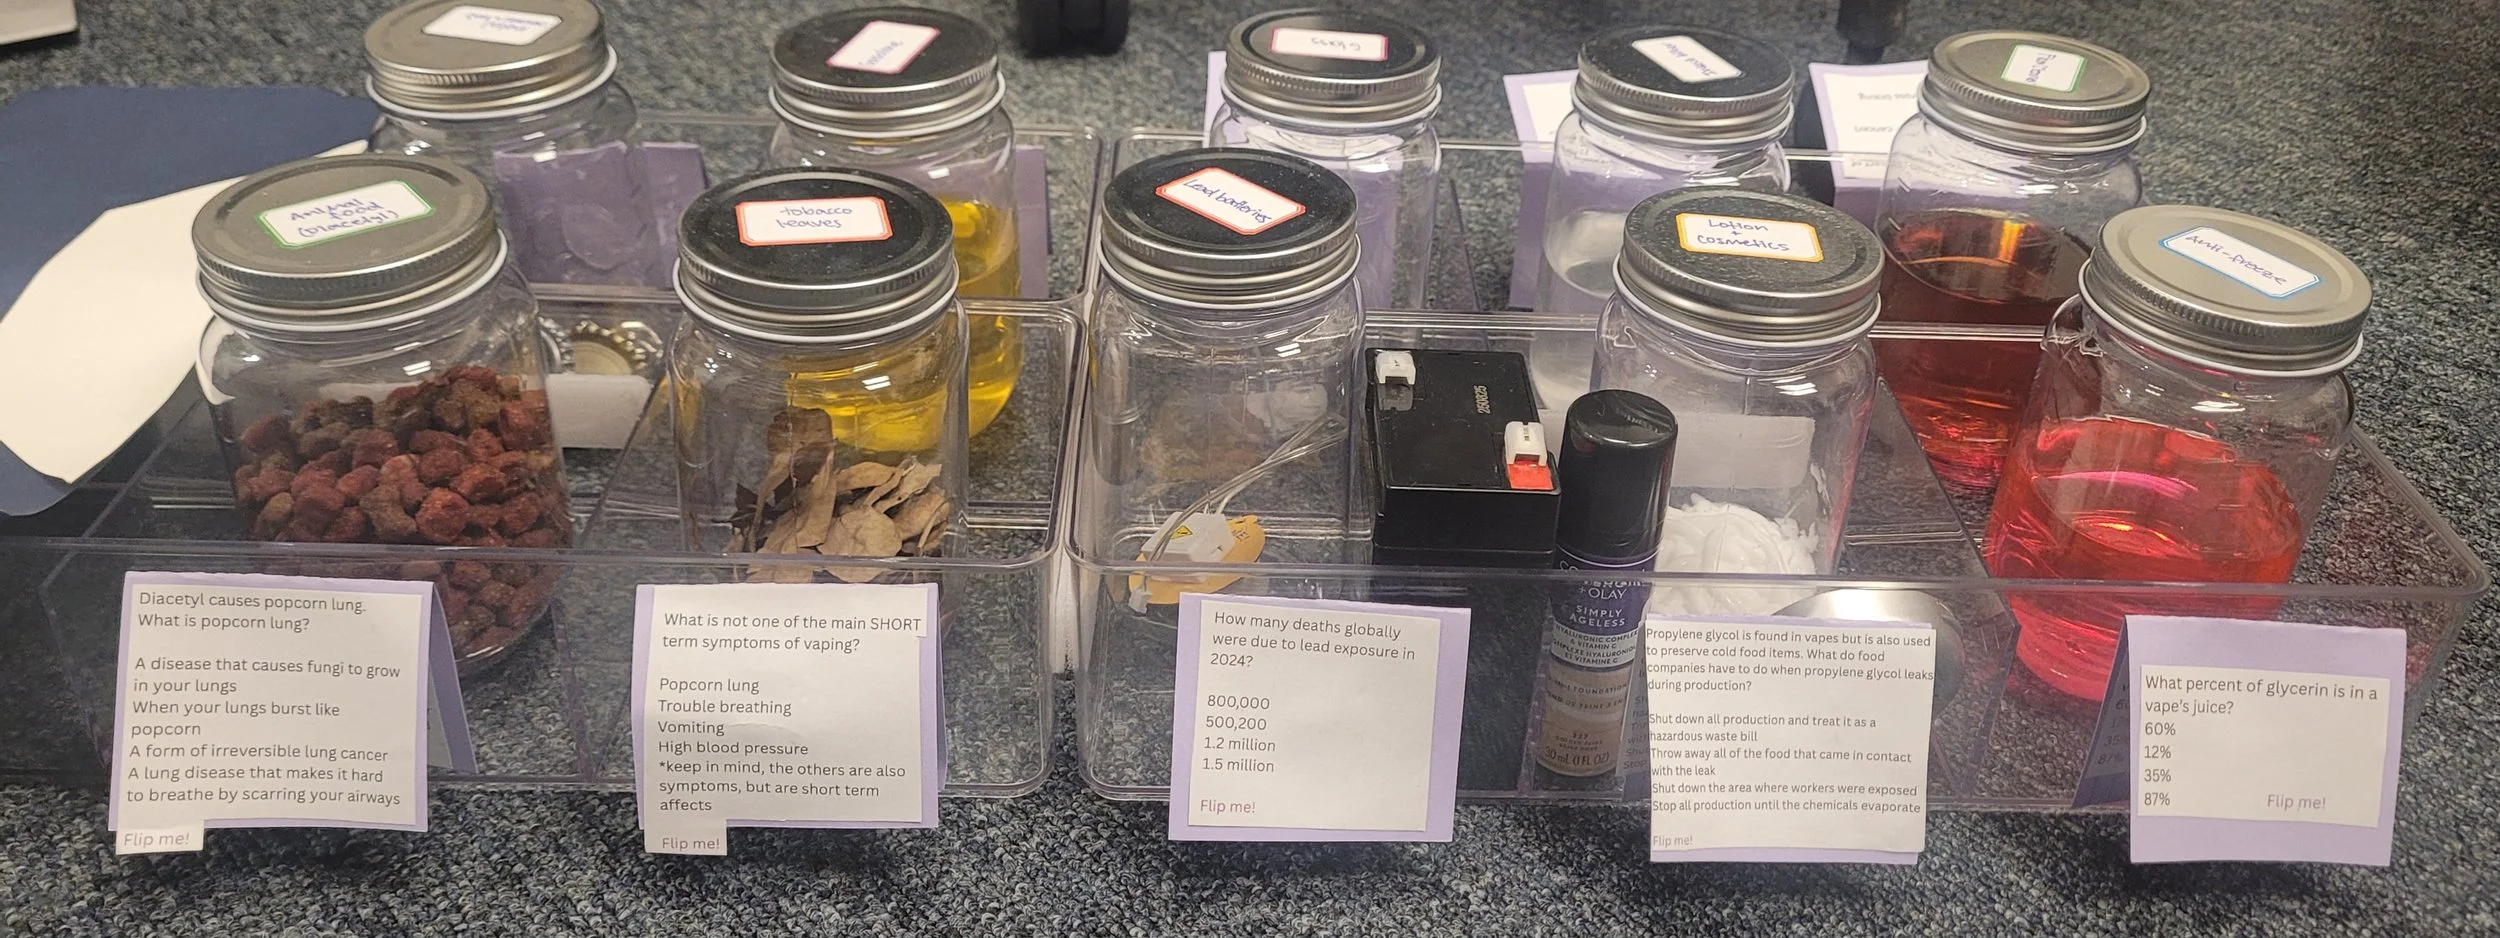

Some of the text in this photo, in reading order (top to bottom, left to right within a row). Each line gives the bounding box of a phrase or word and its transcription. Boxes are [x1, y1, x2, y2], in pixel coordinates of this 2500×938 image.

[1183, 179, 1220, 198] Lead
[329, 201, 384, 220] food
[780, 206, 853, 216] tobacco
[1708, 219, 1769, 231] Lotion
[140, 592, 366, 615] Diacetyl causes popcorn lung.
[1576, 605, 1623, 618] SIMPLY
[138, 613, 310, 633] What is popcorn lung?
[664, 613, 922, 631] What is not one of the main SHORT
[1215, 612, 1401, 641] How many deaths globally
[1569, 612, 1626, 627] AGELESS
[1555, 624, 1638, 643] HYALURONIC COMPLEX
[1646, 628, 1930, 646] Propylene glycol is found in vapes but is also used
[662, 635, 860, 654] term symptoms of vaping?
[1213, 634, 1415, 660] were due to lead exposure in
[1577, 640, 1610, 650] VITAMIN
[1210, 652, 1253, 667] 2024?
[1646, 646, 1885, 662] to preserve cold food items. What do food
[135, 657, 400, 679] A disease that causes fungi to grow
[660, 678, 760, 695] Popcorn lung
[2146, 675, 2377, 700] What percent of glycerin is in a
[133, 700, 340, 718] When your lungs burst like
[658, 699, 792, 718] Trouble breathing
[1208, 694, 1270, 711] 800,000
[2192, 699, 2234, 716] juice?
[1206, 716, 1266, 732] 500,200
[1649, 713, 1673, 724] Shut
[1675, 713, 1704, 724] down
[1706, 714, 1720, 724] all
[1723, 714, 1785, 728] production
[1788, 715, 1809, 726] and
[1812, 716, 1842, 726] treat
[1843, 716, 1851, 727] it
[1854, 719, 1866, 728] as
[1869, 720, 1876, 728] a
[132, 725, 200, 739] popcorn
[658, 721, 724, 737] Vomiting
[1650, 730, 1702, 742] hazardous
[1705, 732, 1738, 742] waste
[1740, 730, 1758, 742] bill
[2145, 722, 2176, 736] 60%
[659, 740, 808, 757] High blood pressure
[1204, 737, 1275, 751] 1.2 million
[2144, 744, 2172, 759] 12%
[1202, 758, 1274, 772] 1.5 million
[2144, 768, 2172, 782] 35%
[660, 780, 879, 796] symptoms, but are short term
[127, 787, 400, 807] to breathe by scarring your airways
[660, 798, 712, 811] affects
[2144, 792, 2170, 806] 87%
[2268, 794, 2326, 811] Flip me!
[1200, 800, 1255, 815] Flip me!
[124, 832, 189, 848] Flip me!
[662, 838, 719, 852] Flip me!
[1653, 836, 1692, 848] Flip me!
